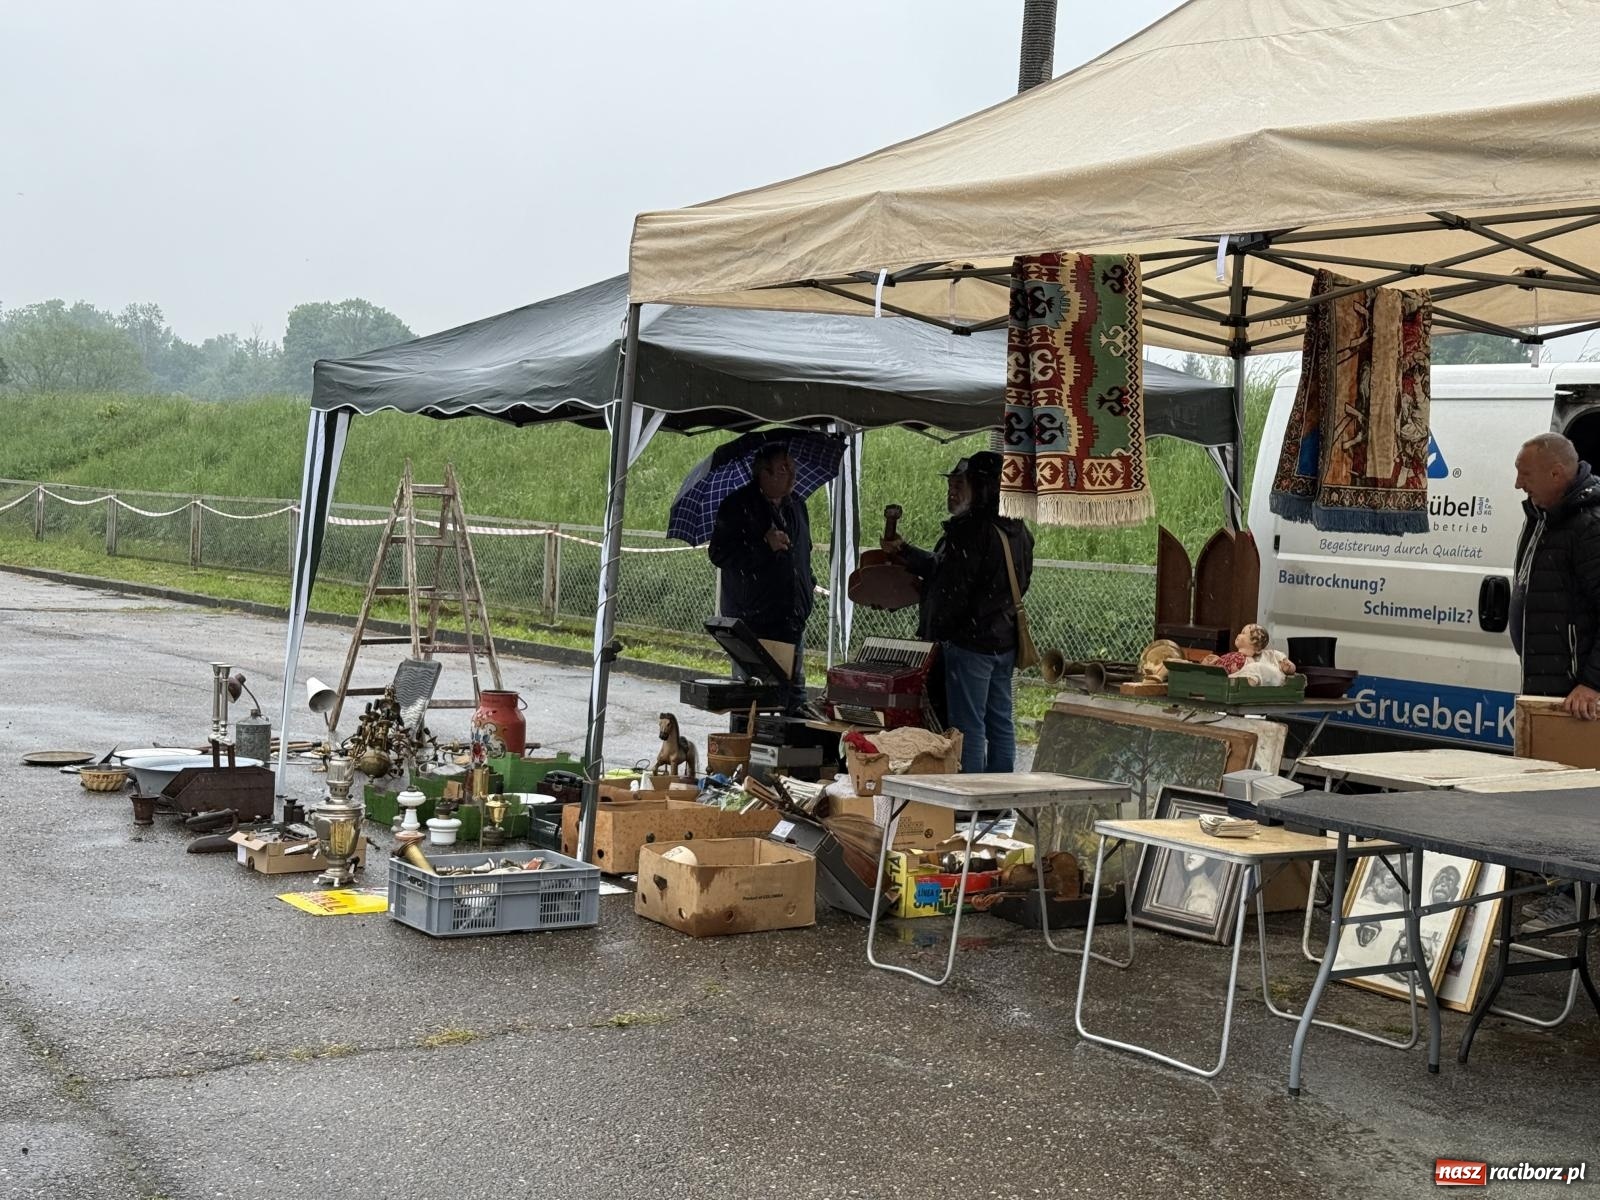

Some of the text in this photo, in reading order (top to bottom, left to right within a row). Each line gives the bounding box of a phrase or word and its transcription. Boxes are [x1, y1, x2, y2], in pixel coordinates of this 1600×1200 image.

[1428, 495, 1476, 517] übel
[1433, 521, 1488, 533] betrieb
[1319, 538, 1483, 558] Begeisterung durch Qualität
[1278, 570, 1386, 594] Bautrocknung?
[1364, 600, 1473, 625] Schimmelpilz?
